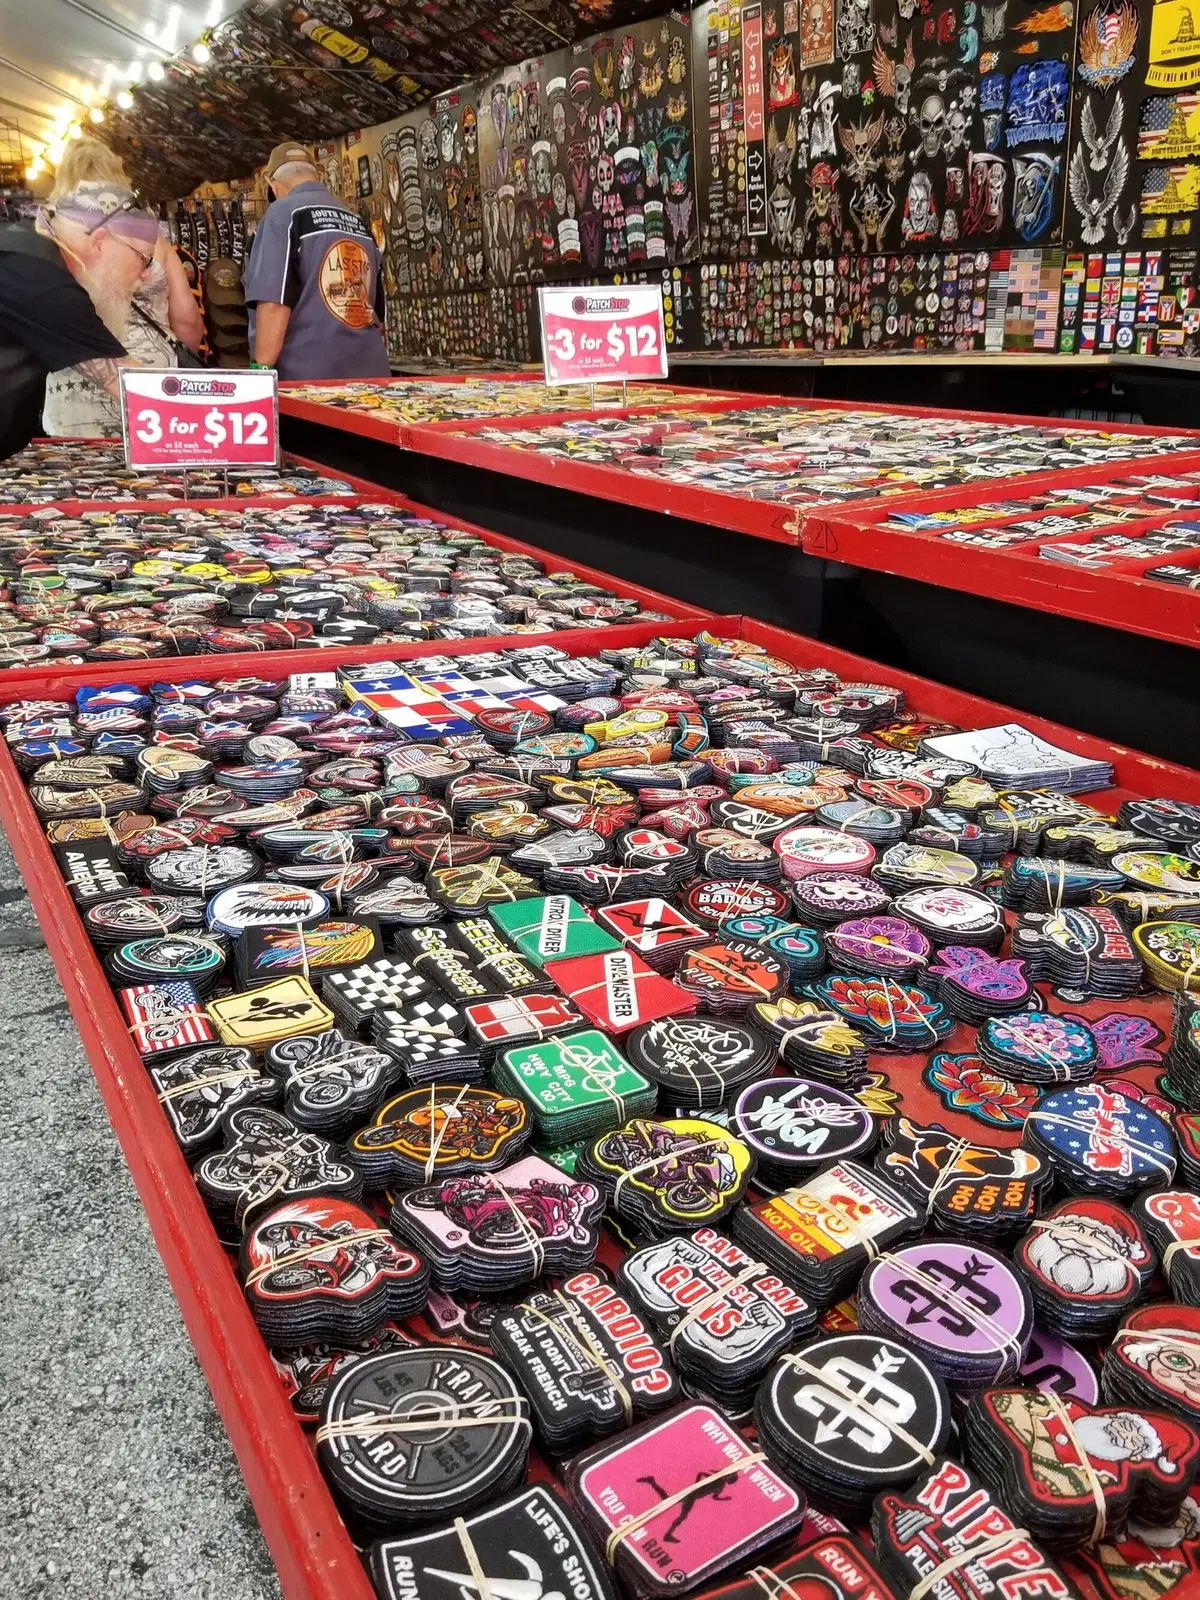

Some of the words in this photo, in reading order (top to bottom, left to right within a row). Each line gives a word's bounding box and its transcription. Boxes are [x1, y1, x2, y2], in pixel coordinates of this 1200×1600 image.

[311, 209, 339, 218] SOUTH
[328, 257, 351, 271] LAST
[552, 328, 576, 360] 3
[580, 333, 602, 350] for
[607, 322, 658, 362] $12
[136, 409, 163, 443] 3
[169, 417, 198, 434] for
[203, 407, 268, 448] $12
[699, 893, 776, 905] BADASS
[703, 882, 773, 896] CERTIFIED
[544, 927, 562, 953] DIVER
[725, 940, 761, 960] LOVE
[763, 955, 781, 974] TO
[610, 957, 633, 1018] DIVEMASTER
[683, 966, 726, 990] RIDE
[527, 1053, 552, 1079] HWY
[662, 1040, 694, 1058] LIVE
[548, 1081, 575, 1103] CITY
[552, 1064, 577, 1088] MPG
[753, 1095, 830, 1153] YOGA
[830, 1166, 868, 1196] BURN
[870, 1195, 900, 1219] FAT
[947, 1184, 976, 1212] HO!
[973, 1184, 1001, 1212] HO!
[1002, 1181, 1026, 1207] HO!
[760, 1207, 794, 1233] NOT
[790, 1231, 817, 1255] OIL
[656, 1263, 747, 1337] GUNS
[752, 1275, 808, 1316] BAN
[535, 1330, 547, 1338] I
[564, 1272, 673, 1396] CARDIO?
[577, 1316, 608, 1357] SORRY
[502, 1318, 534, 1357] SPEAK
[528, 1356, 568, 1411] FRENCH
[438, 1360, 501, 1418] TRAIN
[701, 1419, 724, 1445] WHY
[722, 1442, 756, 1476] WAK
[750, 1471, 785, 1502] WHEN
[524, 1499, 570, 1555] LIFE'S
[598, 1486, 625, 1515] YOU
[619, 1514, 648, 1542] CN
[641, 1537, 673, 1568] RUN
[917, 1461, 1072, 1600] RIPPE
[942, 1533, 966, 1557] FO
[819, 1547, 863, 1587] RUN
